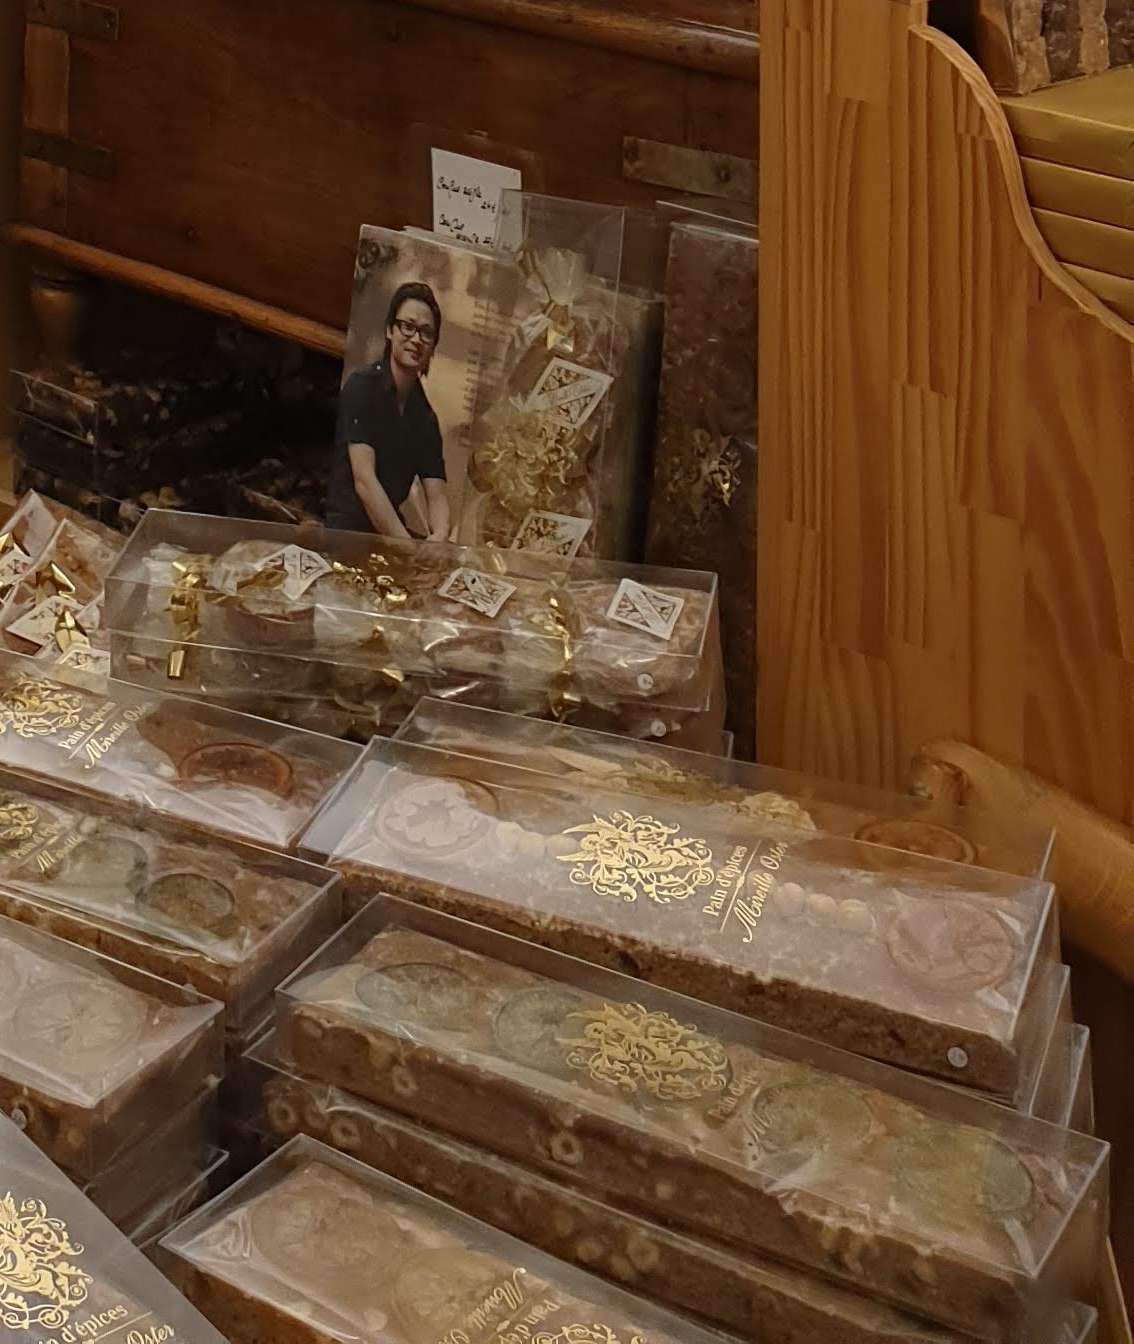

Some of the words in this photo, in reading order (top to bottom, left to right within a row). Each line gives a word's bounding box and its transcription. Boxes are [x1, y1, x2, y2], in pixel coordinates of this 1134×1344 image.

[58, 731, 85, 749] Pain
[85, 722, 129, 769] Mireille
[702, 889, 728, 917] Pain
[716, 845, 748, 887] d'épices
[734, 872, 774, 943] Mireille
[62, 1304, 128, 1343] d'épices
